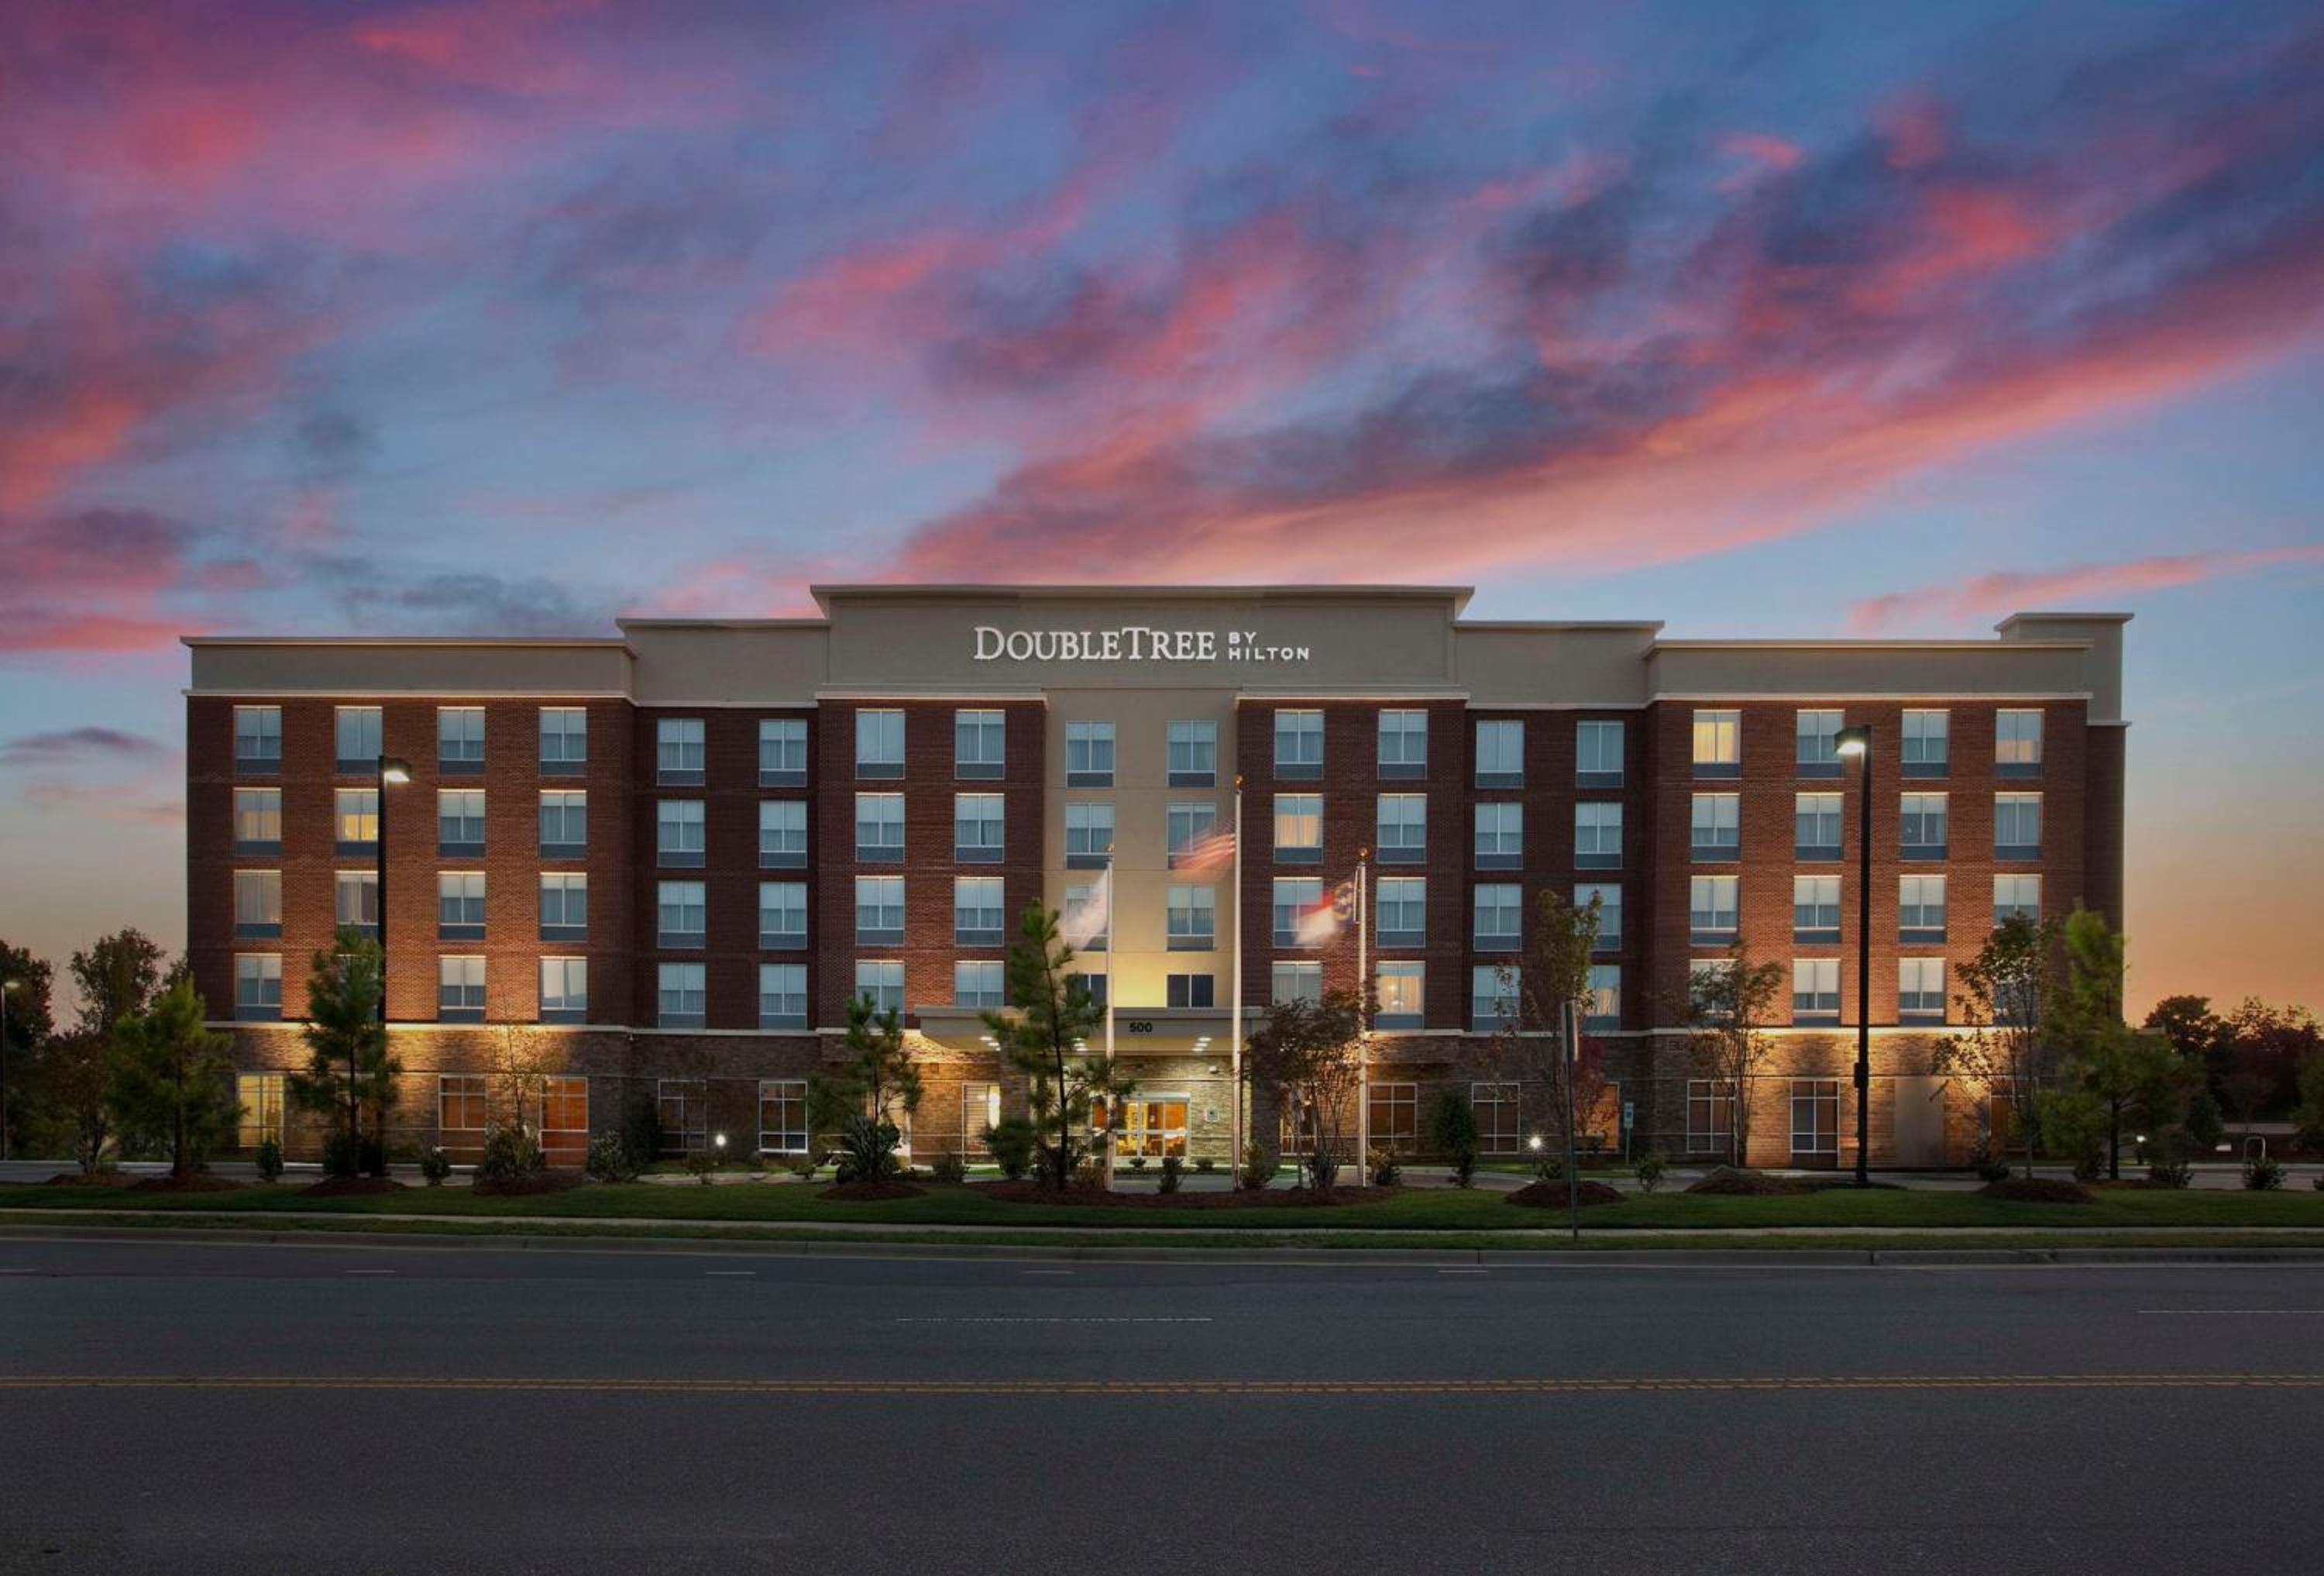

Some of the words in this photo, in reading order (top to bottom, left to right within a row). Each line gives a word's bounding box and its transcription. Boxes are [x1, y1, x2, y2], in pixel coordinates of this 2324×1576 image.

[1229, 631, 1257, 645] BY
[1229, 647, 1311, 661] HILTON
[1129, 1021, 1153, 1033] 500
